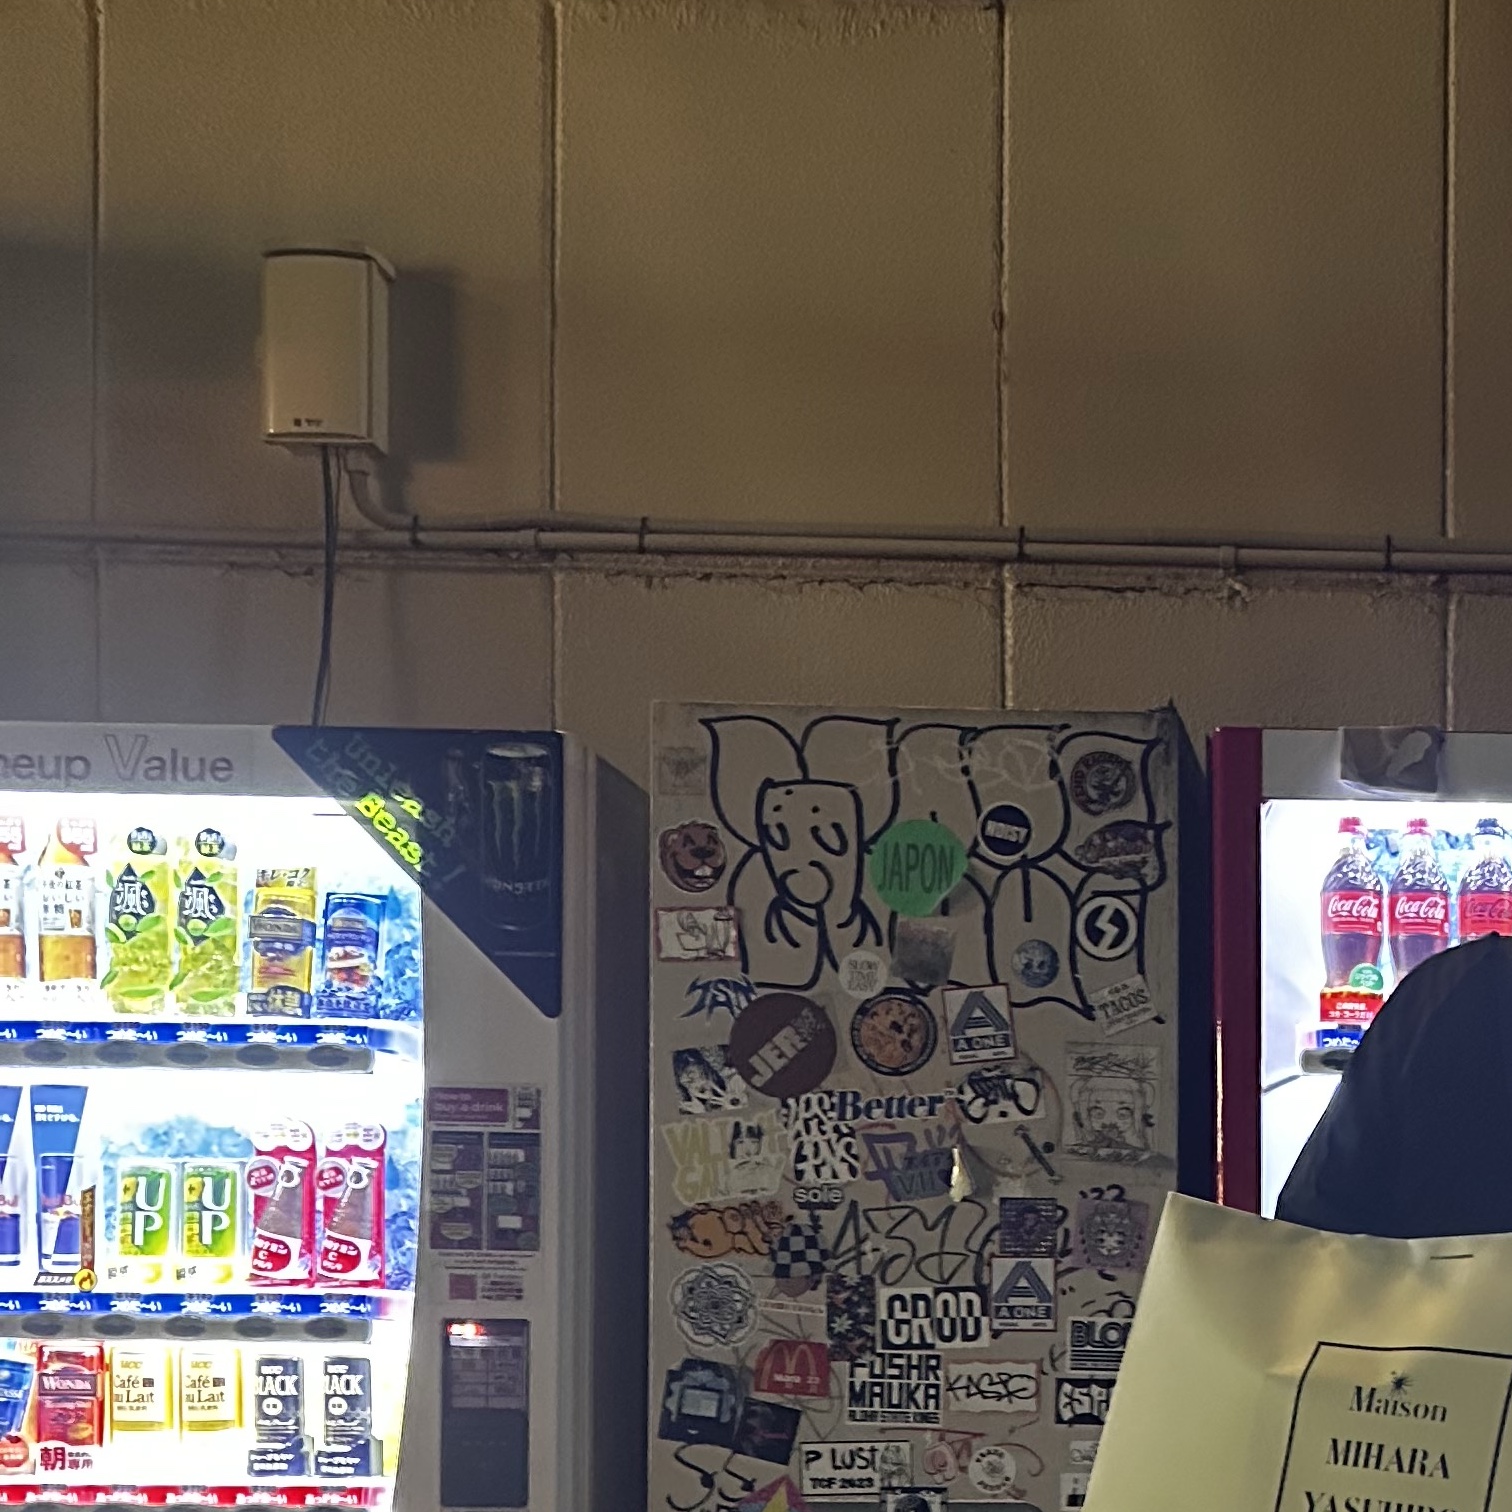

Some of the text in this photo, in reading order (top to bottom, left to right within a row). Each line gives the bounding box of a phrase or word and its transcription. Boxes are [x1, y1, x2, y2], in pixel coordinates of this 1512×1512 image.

[104, 734, 234, 782] Value
[875, 843, 957, 894] JAPON
[1327, 895, 1379, 919] Coca-Cola
[1394, 895, 1447, 919] Coca-Cola
[956, 1034, 1007, 1051] A ONE
[998, 1305, 1048, 1319] A ONE
[1348, 1384, 1448, 1423] Maison
[40, 1446, 66, 1471] 朝
[831, 1448, 878, 1471] LUST
[1326, 1437, 1450, 1480] MIHARA
